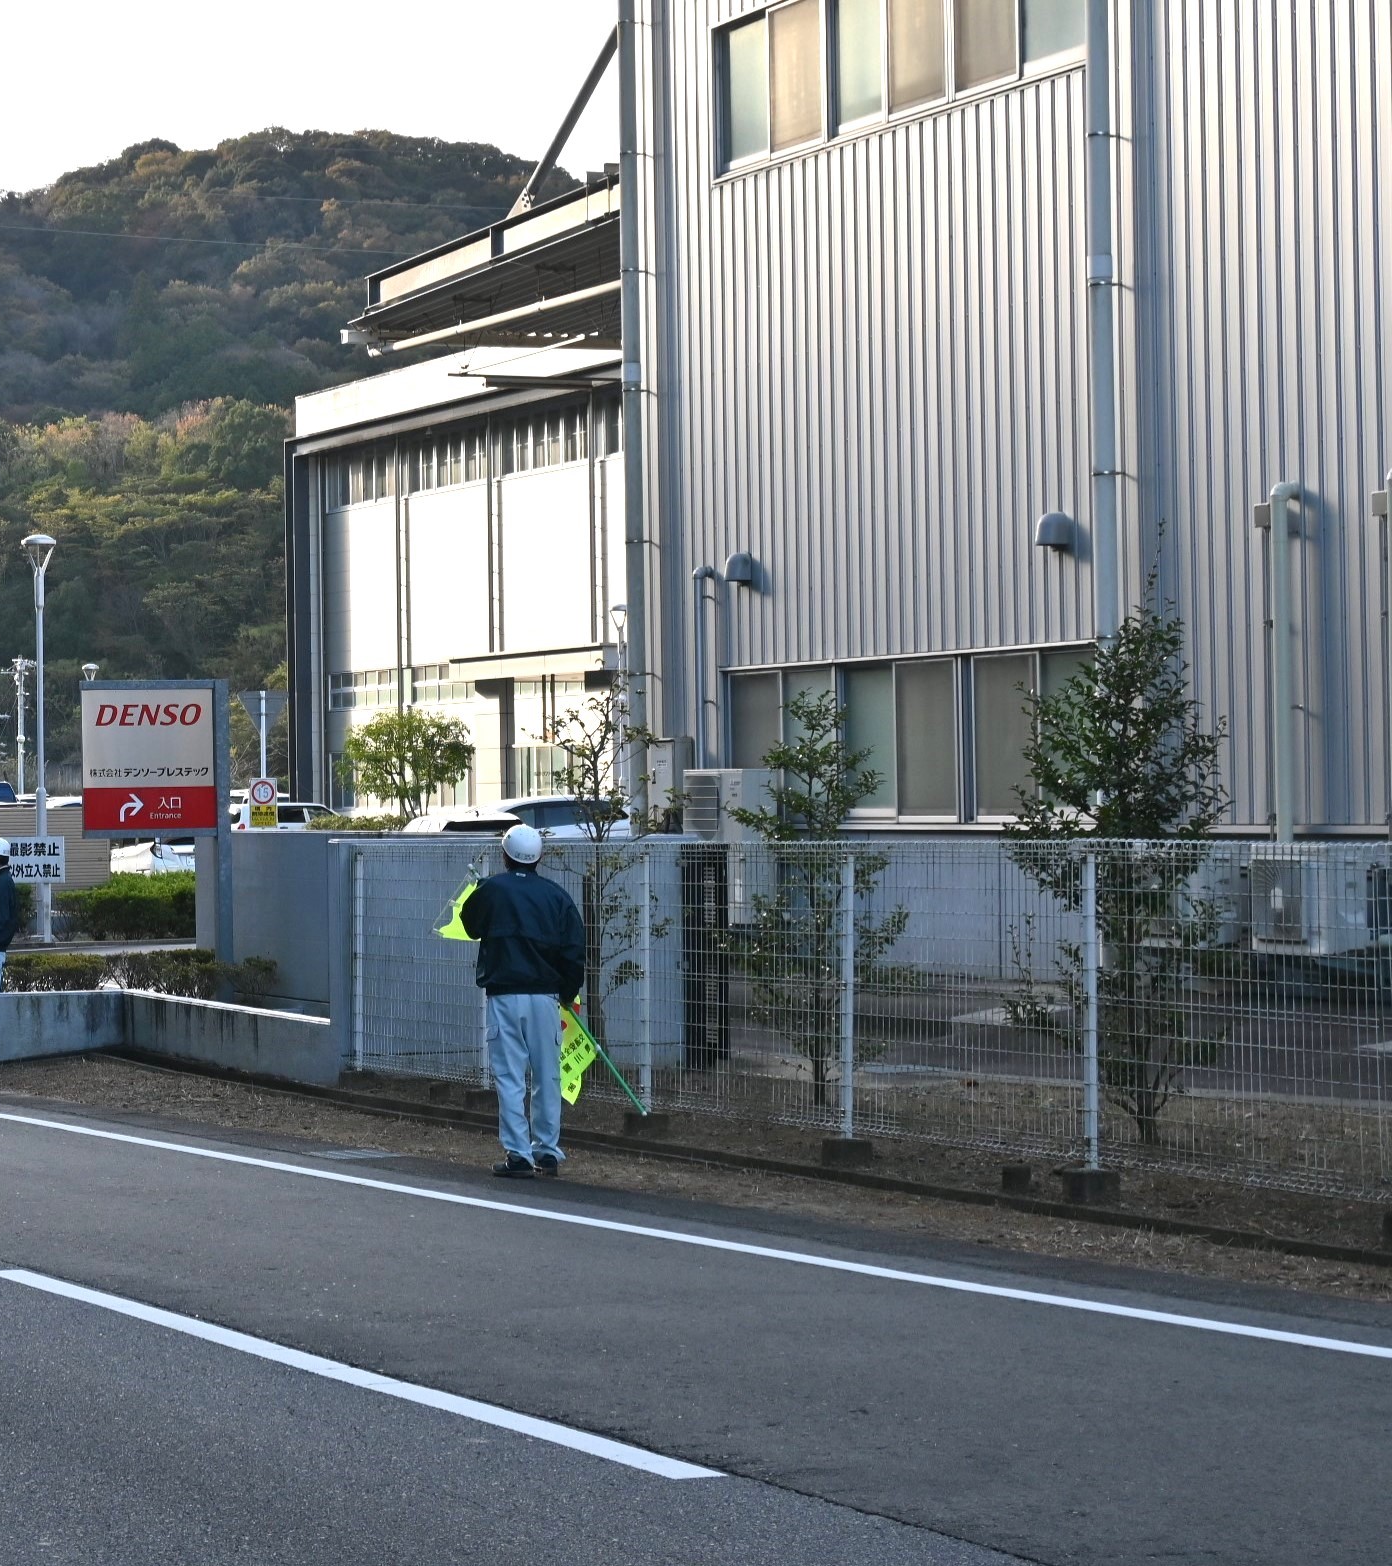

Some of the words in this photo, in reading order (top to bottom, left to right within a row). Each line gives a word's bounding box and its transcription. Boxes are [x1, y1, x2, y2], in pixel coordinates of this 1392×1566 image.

[95, 703, 202, 727] DENSO
[257, 787, 269, 799] 15
[157, 796, 182, 810] 入口
[149, 812, 182, 820] Entrance
